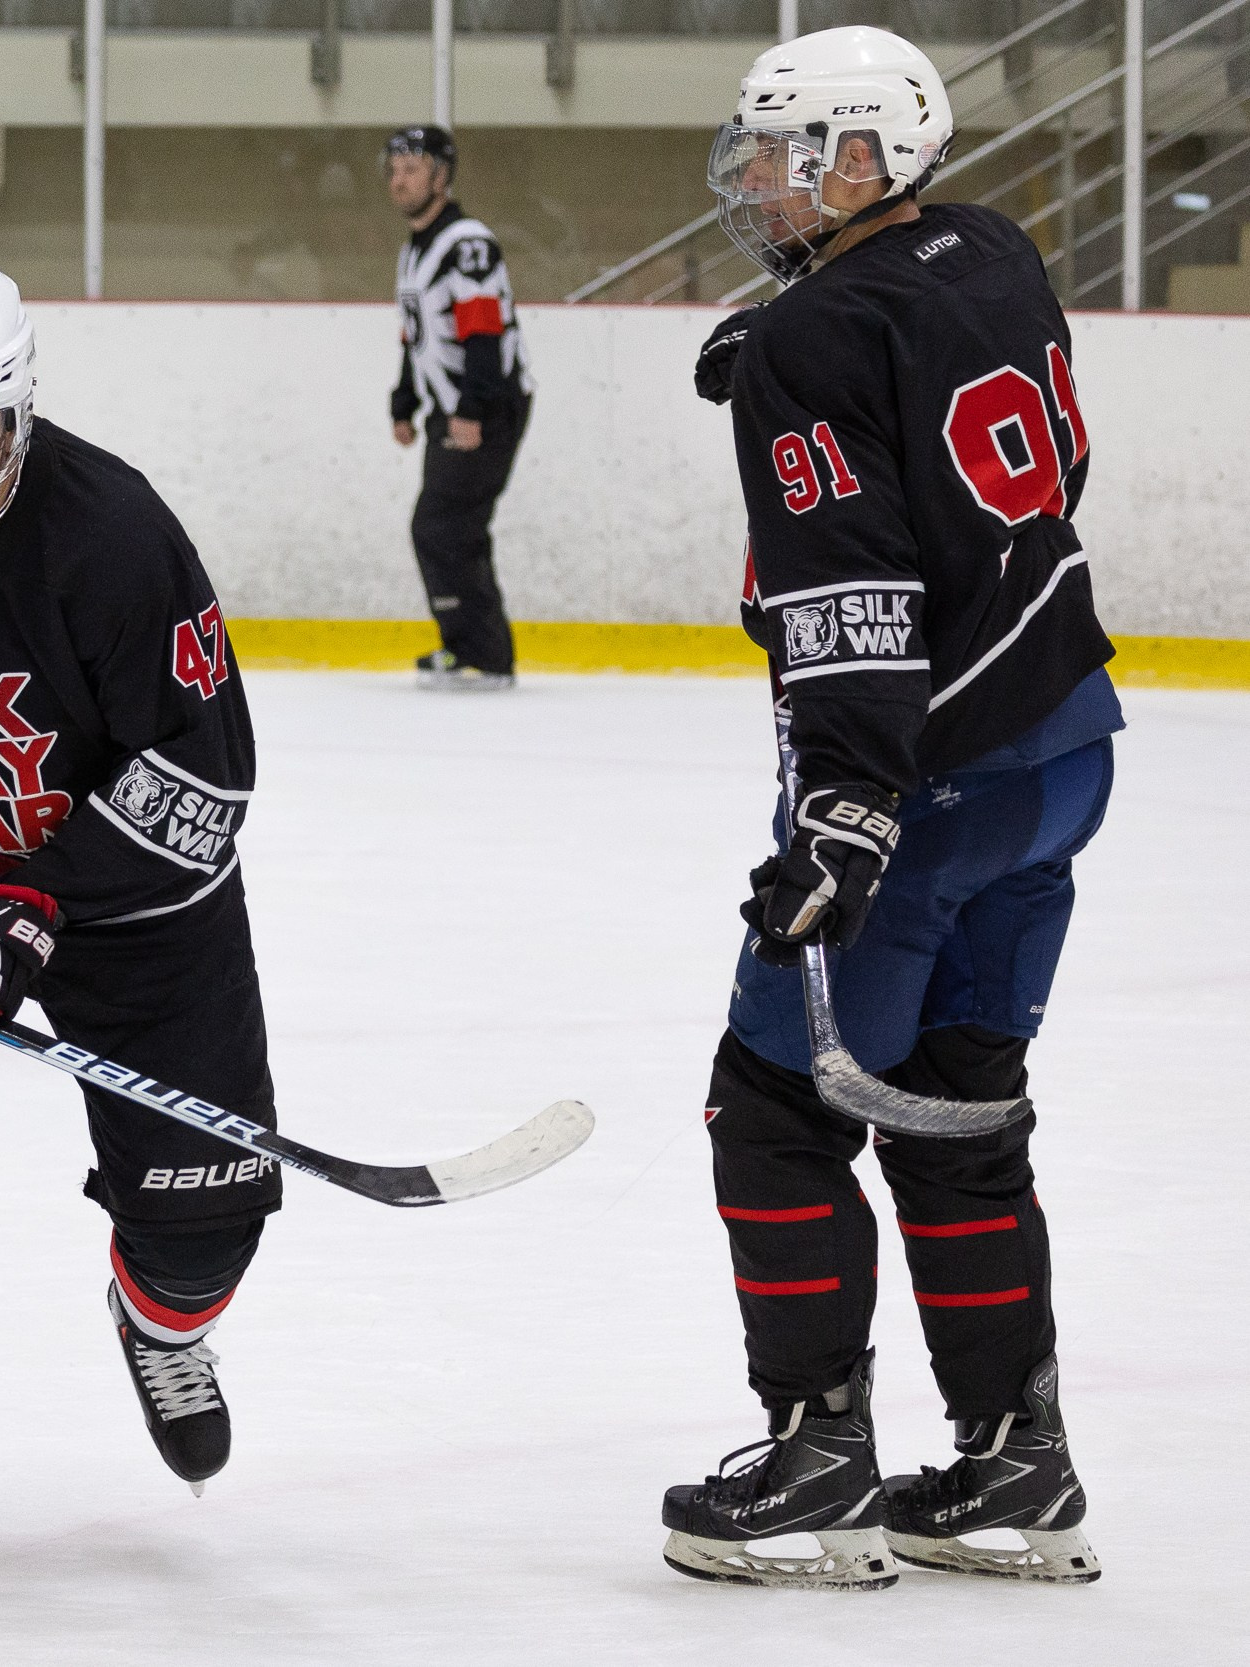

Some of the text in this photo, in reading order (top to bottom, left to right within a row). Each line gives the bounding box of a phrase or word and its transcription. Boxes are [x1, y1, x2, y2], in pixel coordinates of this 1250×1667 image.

[832, 104, 882, 116] CCM
[916, 231, 961, 261] LUTCH
[772, 421, 861, 515] 91
[840, 594, 912, 626] SILK
[172, 600, 229, 700] 47
[844, 626, 913, 656] WAY
[174, 791, 236, 835] SILK
[165, 814, 229, 862] WAY
[44, 1041, 268, 1144] BAUER
[140, 1153, 274, 1190] BAUER
[934, 1496, 983, 1524] CCM
